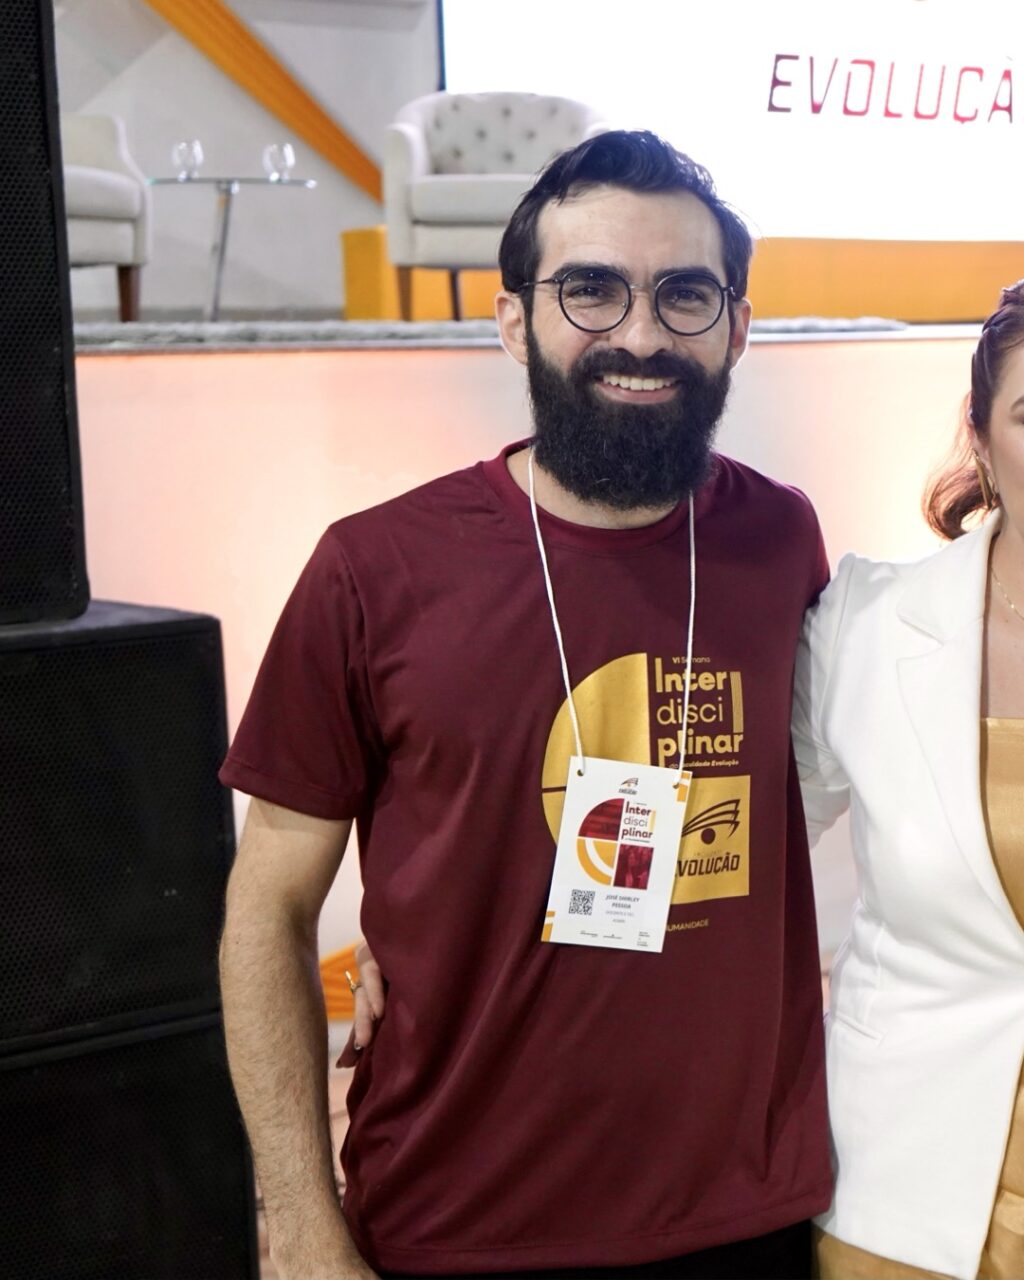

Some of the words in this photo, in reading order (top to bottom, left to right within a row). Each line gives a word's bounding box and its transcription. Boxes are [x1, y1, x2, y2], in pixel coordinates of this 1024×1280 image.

[655, 658, 727, 693] Inter
[656, 697, 722, 725] disci
[658, 728, 744, 768] plinar
[625, 801, 652, 816] Inter
[623, 816, 648, 827] disci
[621, 827, 653, 840] plinar
[675, 852, 741, 878] VOLUÇÃO
[666, 919, 709, 932] UMANIDADE
